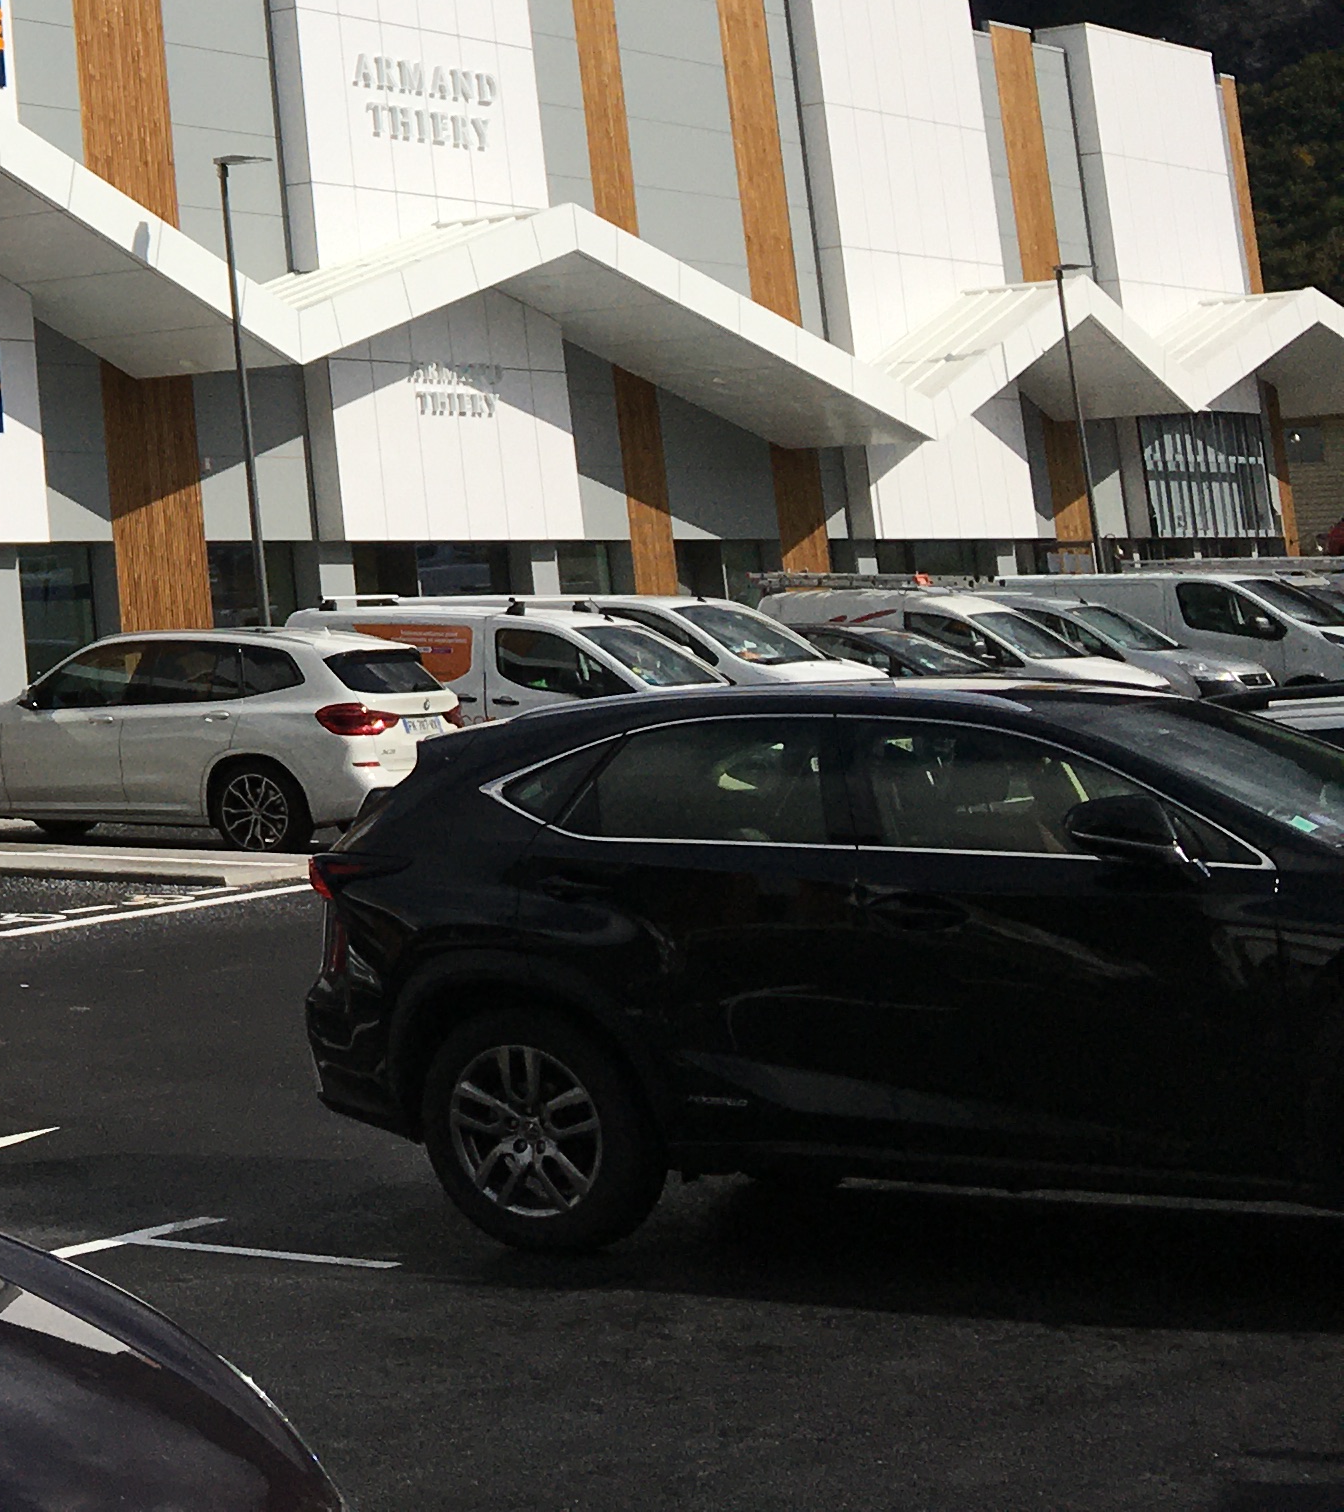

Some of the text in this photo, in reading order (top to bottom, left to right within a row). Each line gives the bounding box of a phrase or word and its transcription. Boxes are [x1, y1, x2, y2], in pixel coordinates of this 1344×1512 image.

[353, 52, 497, 106] ARMAND
[365, 101, 492, 152] THIERY
[415, 391, 500, 418] THIERY
